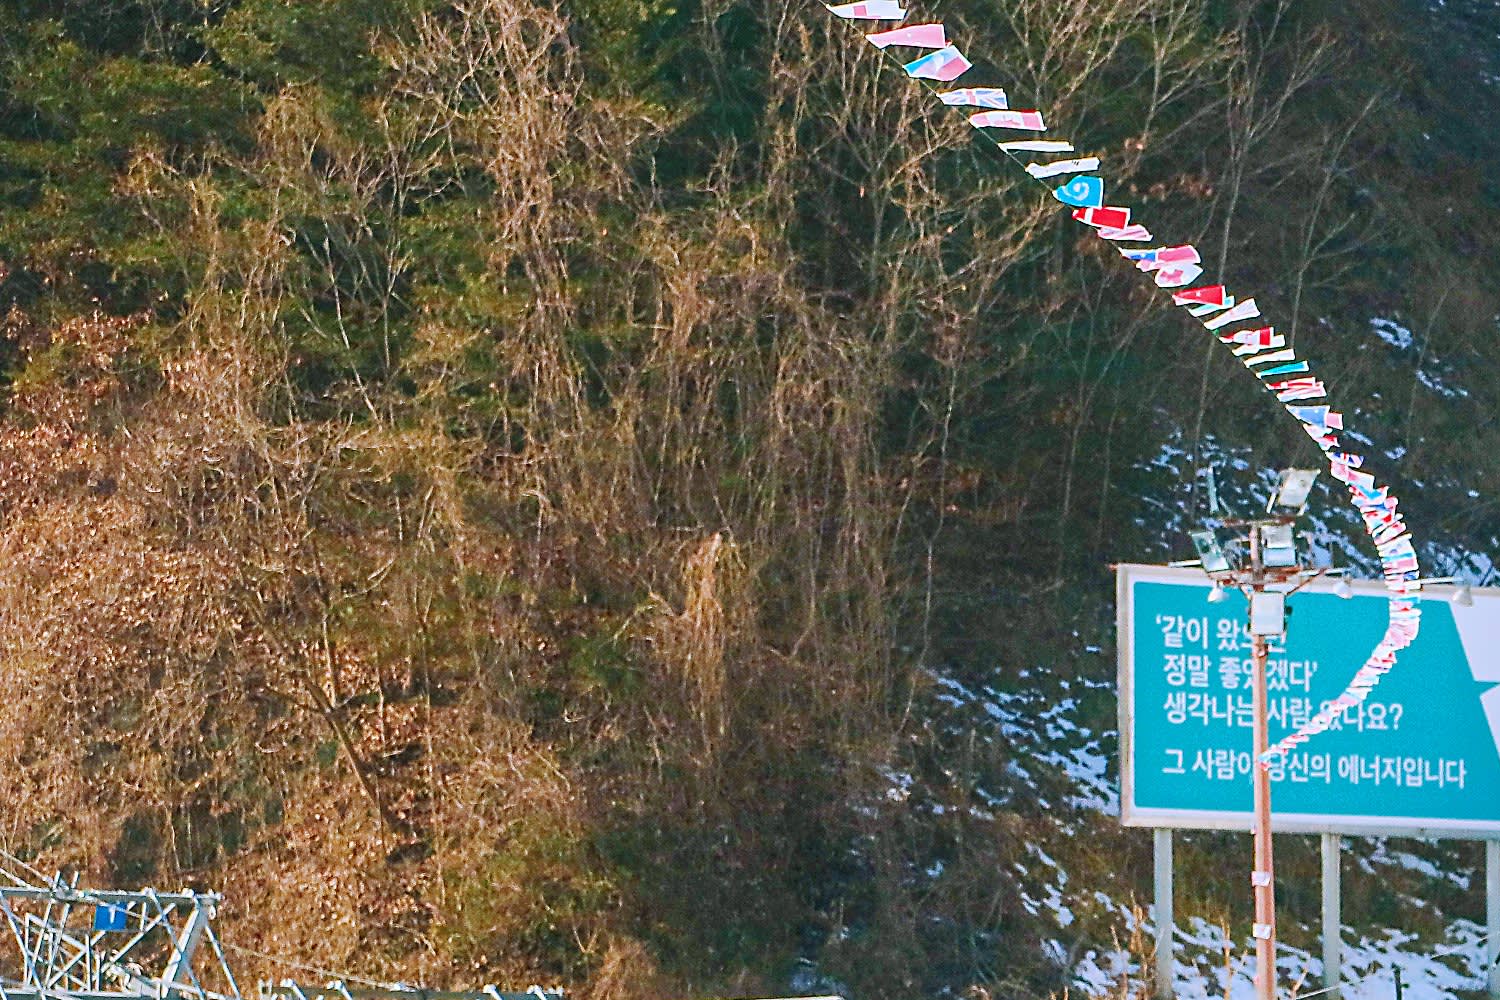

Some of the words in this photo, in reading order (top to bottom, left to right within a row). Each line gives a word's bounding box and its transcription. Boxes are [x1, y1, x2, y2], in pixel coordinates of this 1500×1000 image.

[1163, 653, 1211, 688] 정말
[1163, 692, 1256, 728] 생각나는
[1266, 696, 1313, 730] 사람
[1162, 748, 1186, 774] 그
[1338, 754, 1468, 790] 에너지입니다
